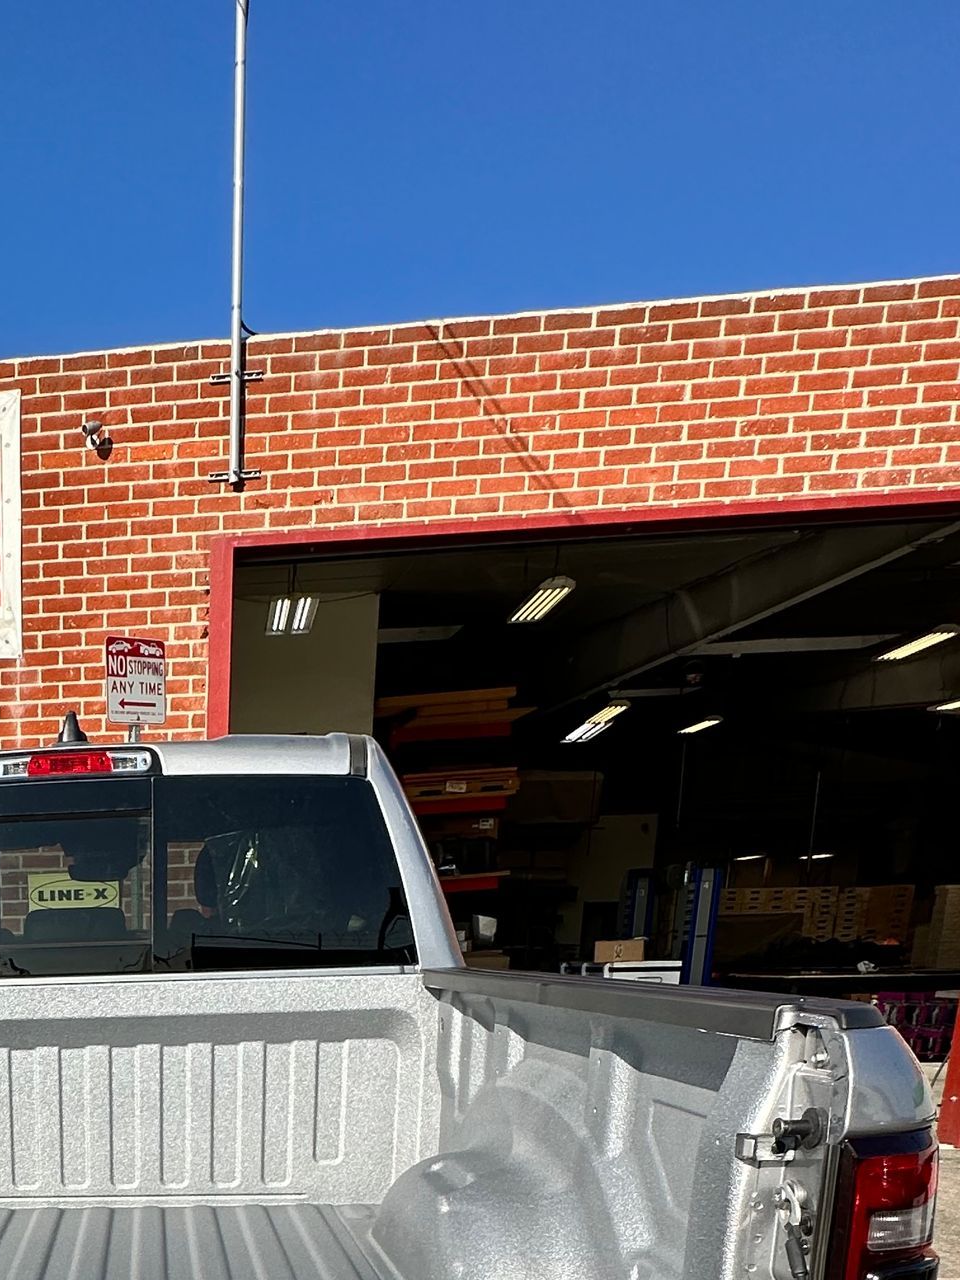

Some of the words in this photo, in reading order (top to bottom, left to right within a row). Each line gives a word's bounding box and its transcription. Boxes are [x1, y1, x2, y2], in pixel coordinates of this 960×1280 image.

[108, 655, 126, 675] NO
[128, 659, 163, 677] STOPPING
[111, 680, 135, 695] ANY
[139, 681, 163, 696] TIME
[38, 887, 108, 902] LINE-X
